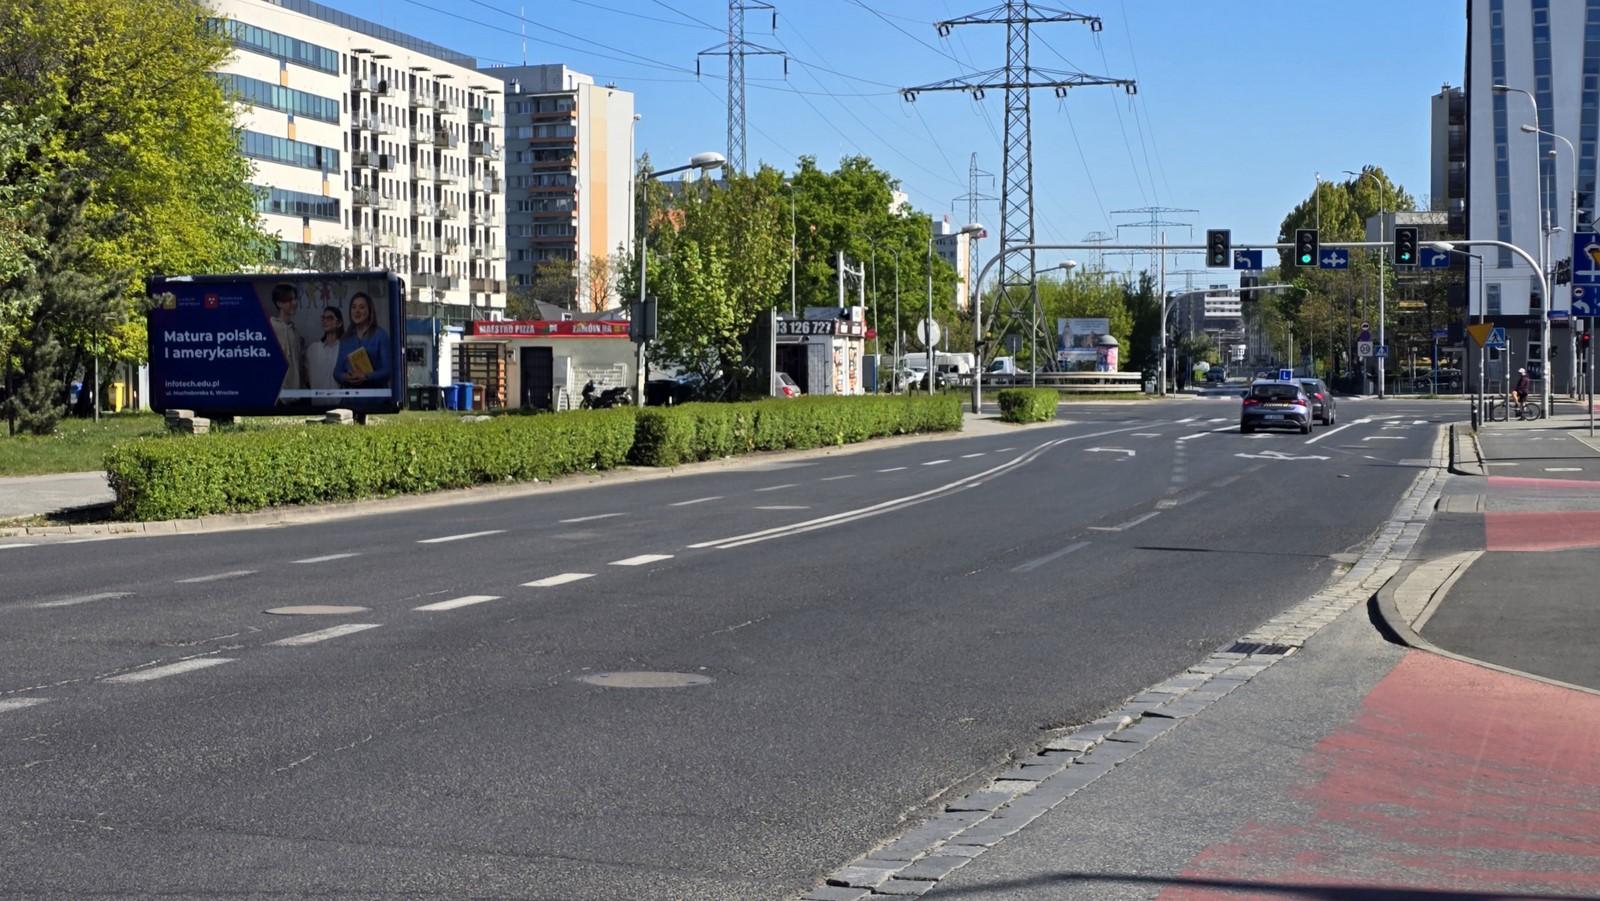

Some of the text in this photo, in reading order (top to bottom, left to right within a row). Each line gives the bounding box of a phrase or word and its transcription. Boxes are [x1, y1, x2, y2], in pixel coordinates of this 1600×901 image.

[479, 324, 514, 334] MAESTRO
[515, 324, 535, 334] PIZZA
[789, 321, 810, 334] 126
[812, 321, 832, 334] 727
[164, 329, 267, 344] Matura polska.
[165, 345, 271, 361] I amerykańska.
